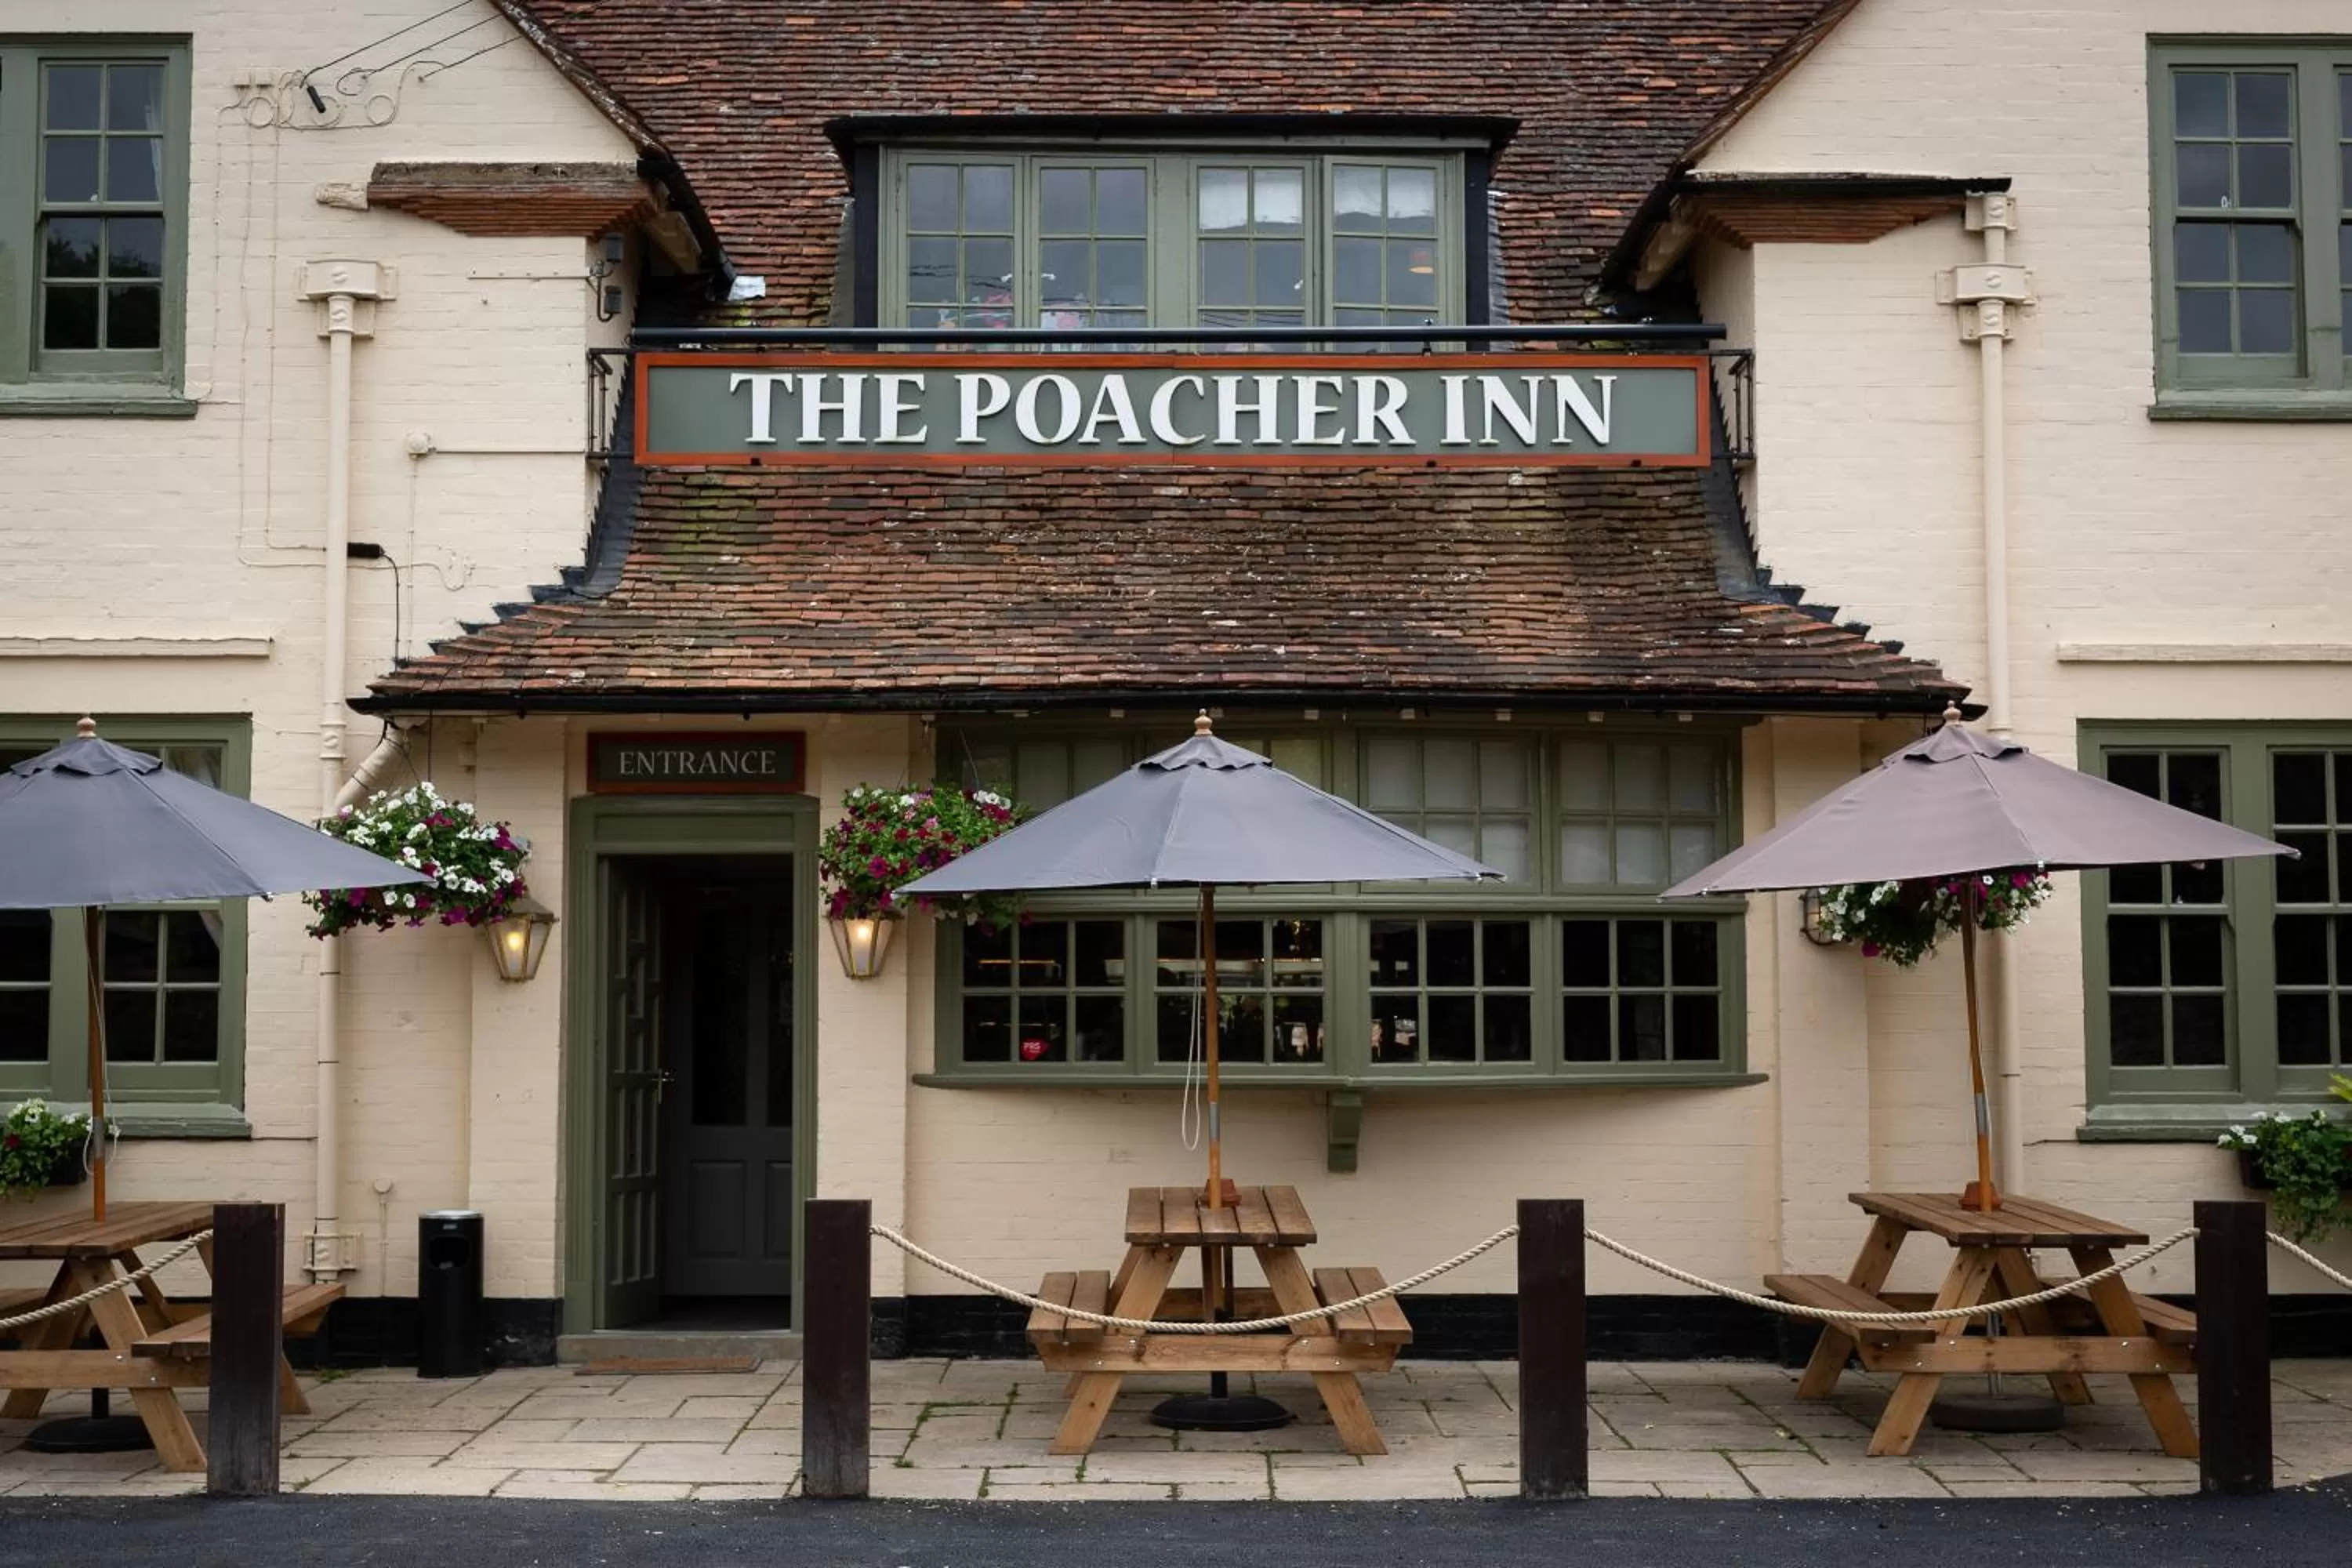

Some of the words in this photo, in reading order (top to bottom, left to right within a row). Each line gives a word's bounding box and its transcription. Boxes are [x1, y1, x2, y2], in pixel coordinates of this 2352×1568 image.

[729, 372, 928, 444] THE
[954, 372, 1417, 445] POACHER
[1440, 374, 1617, 446] INN
[619, 750, 776, 775] ENTRANCE
